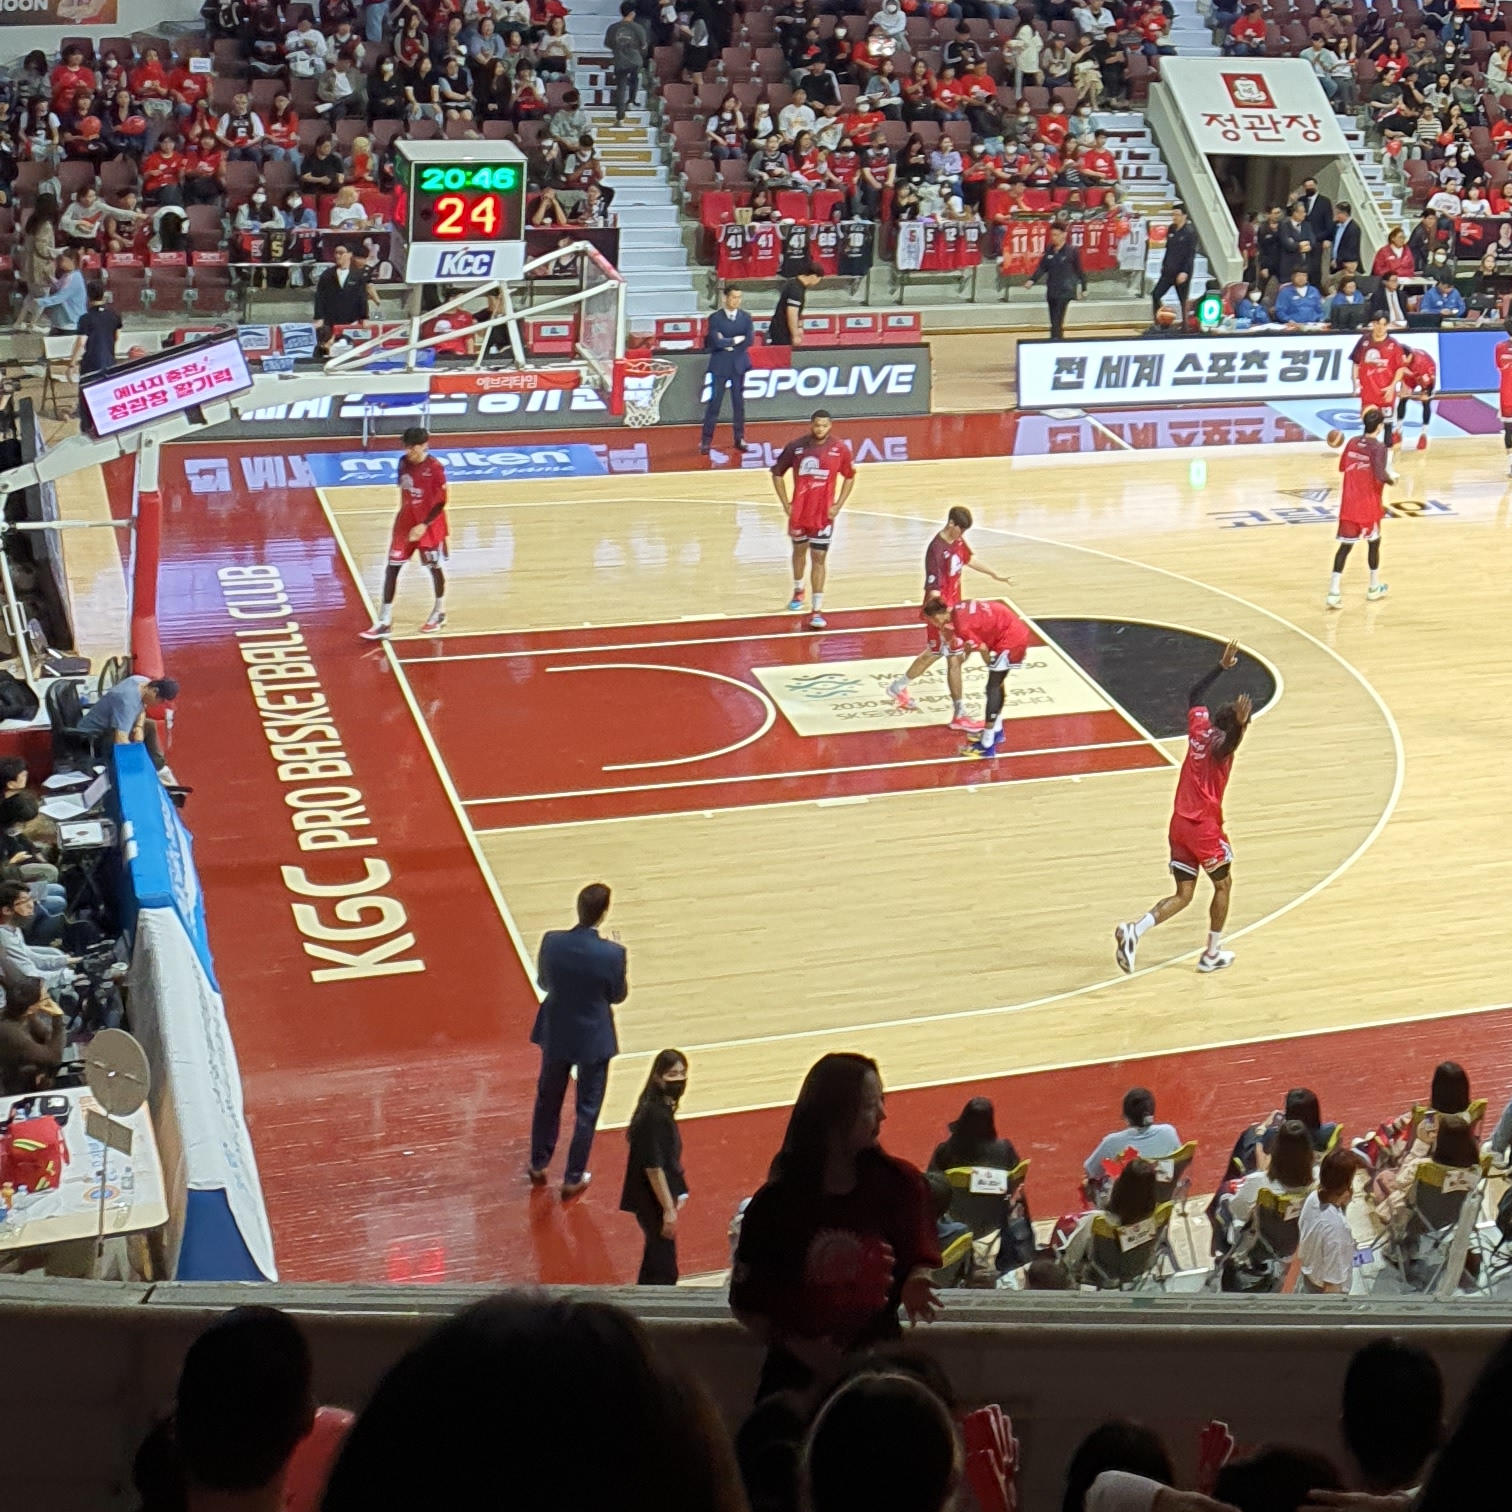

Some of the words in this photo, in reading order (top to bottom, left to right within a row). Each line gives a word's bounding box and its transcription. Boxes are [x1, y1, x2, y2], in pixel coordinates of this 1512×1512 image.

[1201, 113, 1322, 142] 정관장
[422, 167, 516, 190] 20:46
[436, 196, 497, 234] 24
[440, 250, 491, 276] KCC
[476, 374, 539, 389] 에브리타임
[743, 363, 917, 399] SPOLIVE
[1052, 356, 1087, 391] 전
[1095, 353, 1164, 389] 세계
[1172, 349, 1270, 385] 스포츠
[1279, 348, 1342, 382] 경기
[114, 374, 164, 400] 에너지
[107, 389, 169, 421] 정관장
[1206, 498, 1460, 529] 코랄안
[216, 564, 294, 620] CLUB
[235, 620, 353, 782] BASKETBALL
[284, 786, 379, 851] PRO
[280, 857, 426, 983] KGC
